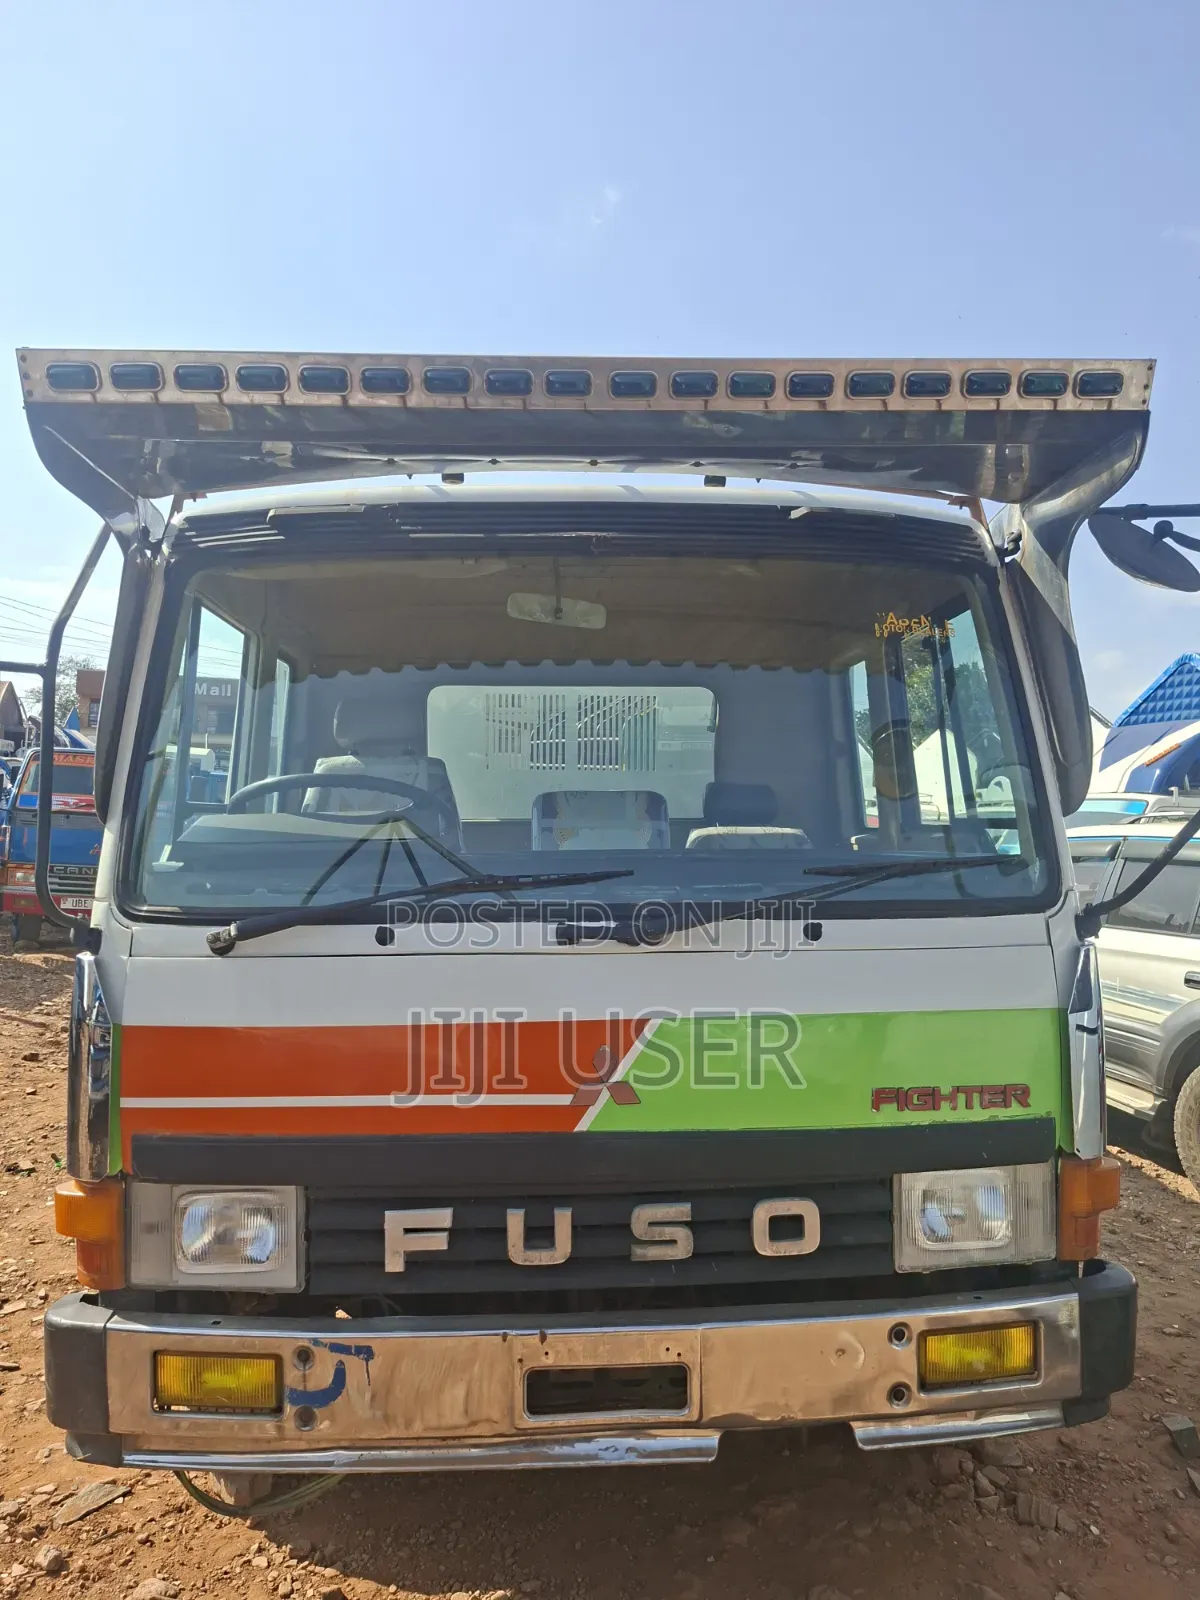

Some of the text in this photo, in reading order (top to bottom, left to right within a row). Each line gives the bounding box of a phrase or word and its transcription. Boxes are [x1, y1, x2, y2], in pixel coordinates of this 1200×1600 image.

[194, 682, 232, 697] Mall
[53, 866, 98, 874] CAN
[871, 1083, 1032, 1112] FIGHTER
[384, 1197, 821, 1272] FUSO
